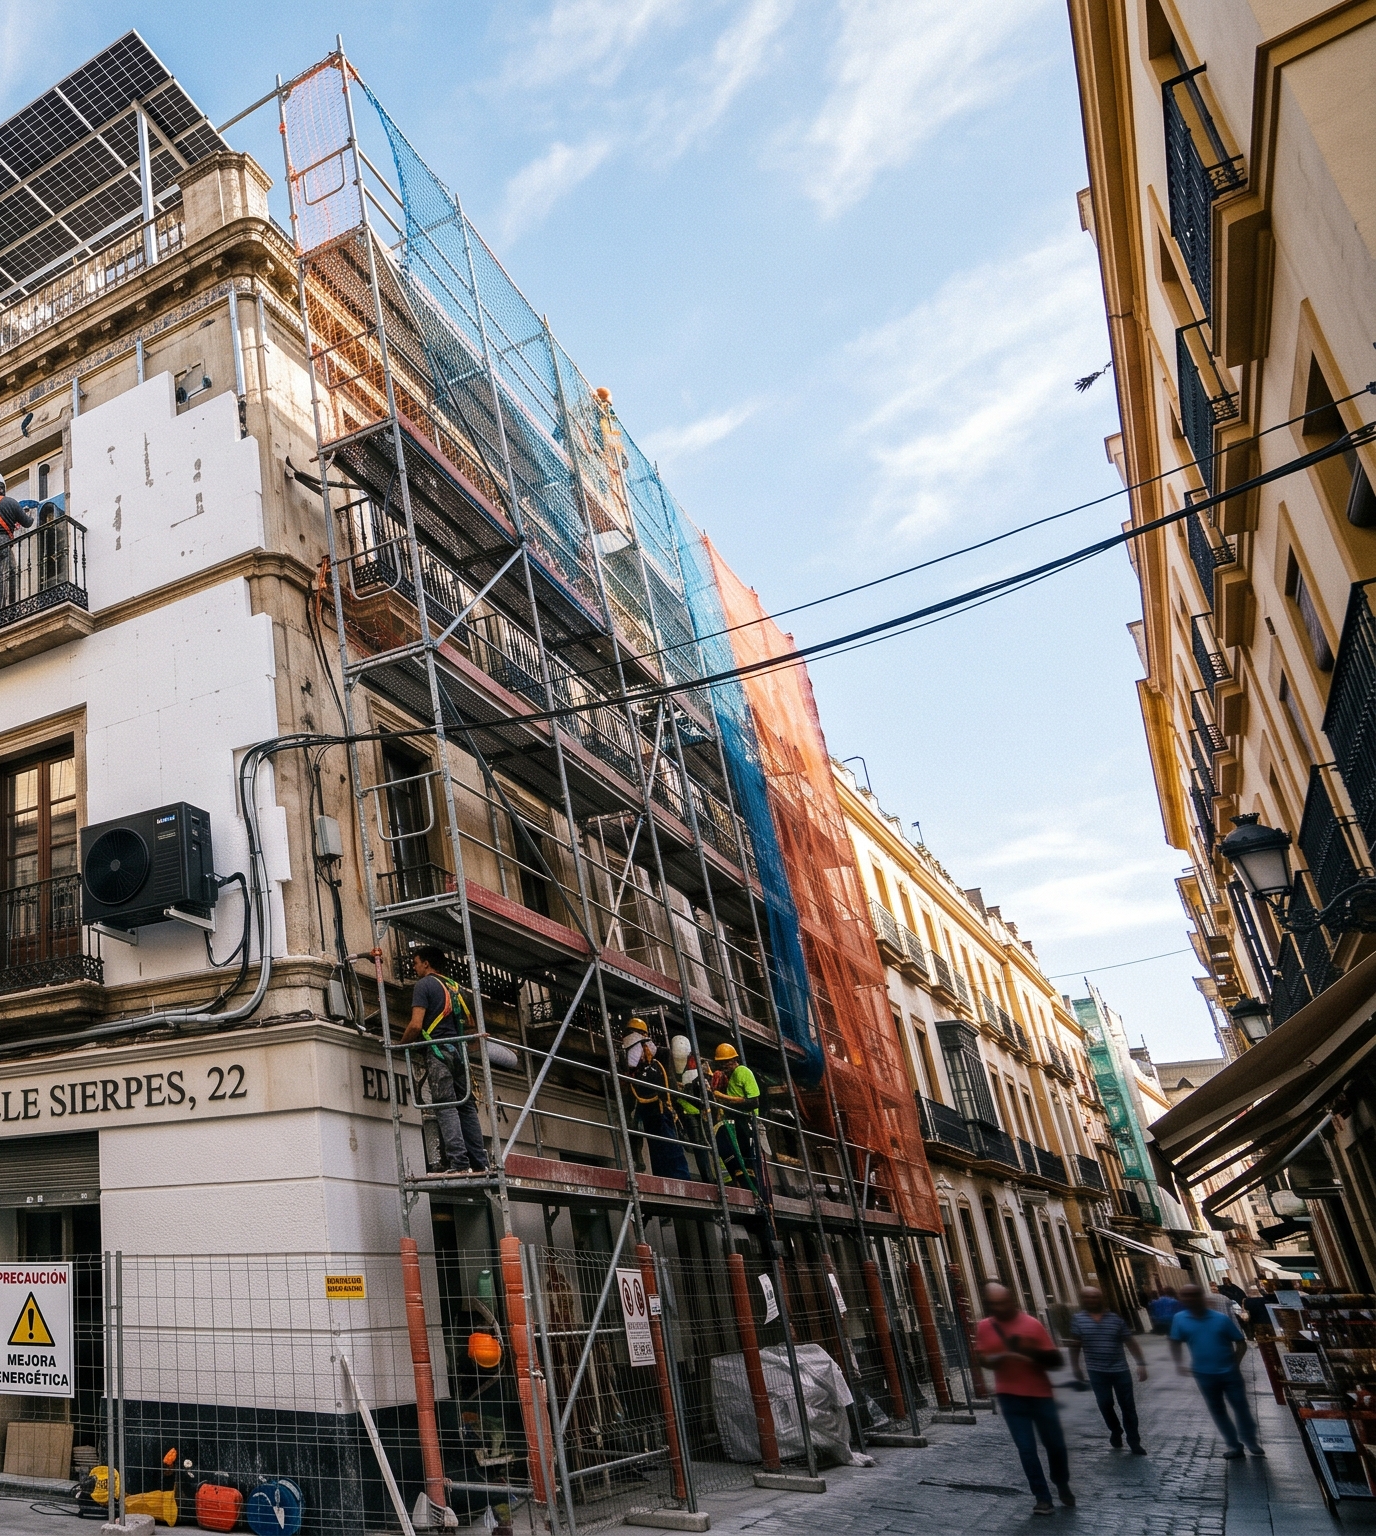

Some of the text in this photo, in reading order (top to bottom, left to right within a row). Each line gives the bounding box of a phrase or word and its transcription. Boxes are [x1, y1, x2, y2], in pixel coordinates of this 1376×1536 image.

[50, 1070, 197, 1117] SIERPES,
[207, 1064, 248, 1101] 22
[7, 1353, 57, 1367] MEJORA
